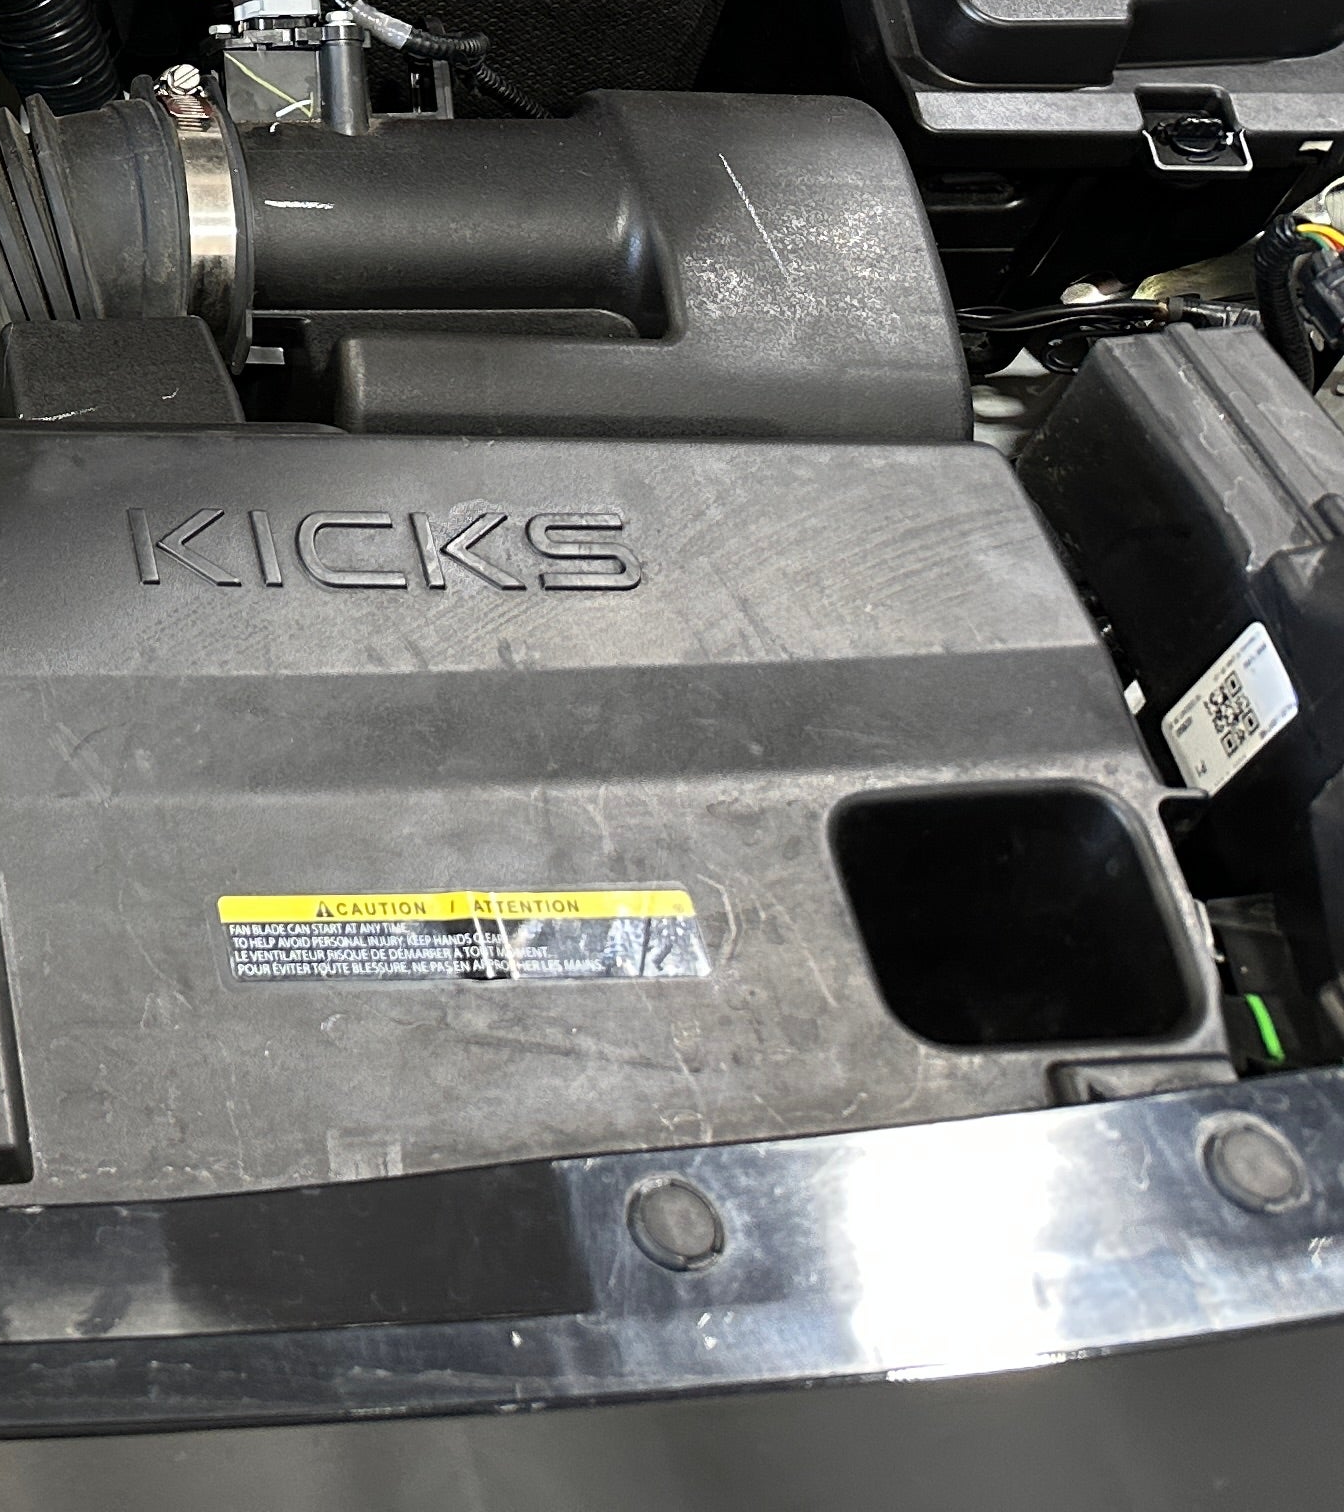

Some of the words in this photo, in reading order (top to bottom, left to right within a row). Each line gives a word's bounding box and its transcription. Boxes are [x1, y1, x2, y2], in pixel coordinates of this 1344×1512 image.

[126, 507, 642, 590] KICKS
[336, 900, 426, 916] CAUTION
[473, 899, 579, 914] ATTENTION
[229, 924, 250, 936] FAN
[252, 924, 285, 935] BLADE
[287, 924, 311, 935] CAN
[312, 923, 343, 935] START
[345, 923, 357, 934] AT
[359, 923, 381, 935] ANY
[233, 937, 248, 948] TO
[250, 937, 275, 948] HELP
[278, 937, 310, 948] AVOID
[312, 936, 367, 948] PERSONAL
[407, 935, 431, 946] KEEP
[434, 933, 471, 945] HANDS
[234, 950, 249, 962] LE
[250, 949, 325, 961] VENTILATEUR
[326, 949, 369, 961] RISQUE
[370, 948, 387, 960] DE
[237, 963, 269, 976] POUR
[272, 961, 311, 975] ÉVITER
[313, 962, 349, 975] TOUTE
[412, 961, 429, 972] NE
[430, 961, 451, 973] PAS
[453, 960, 469, 972] EN
